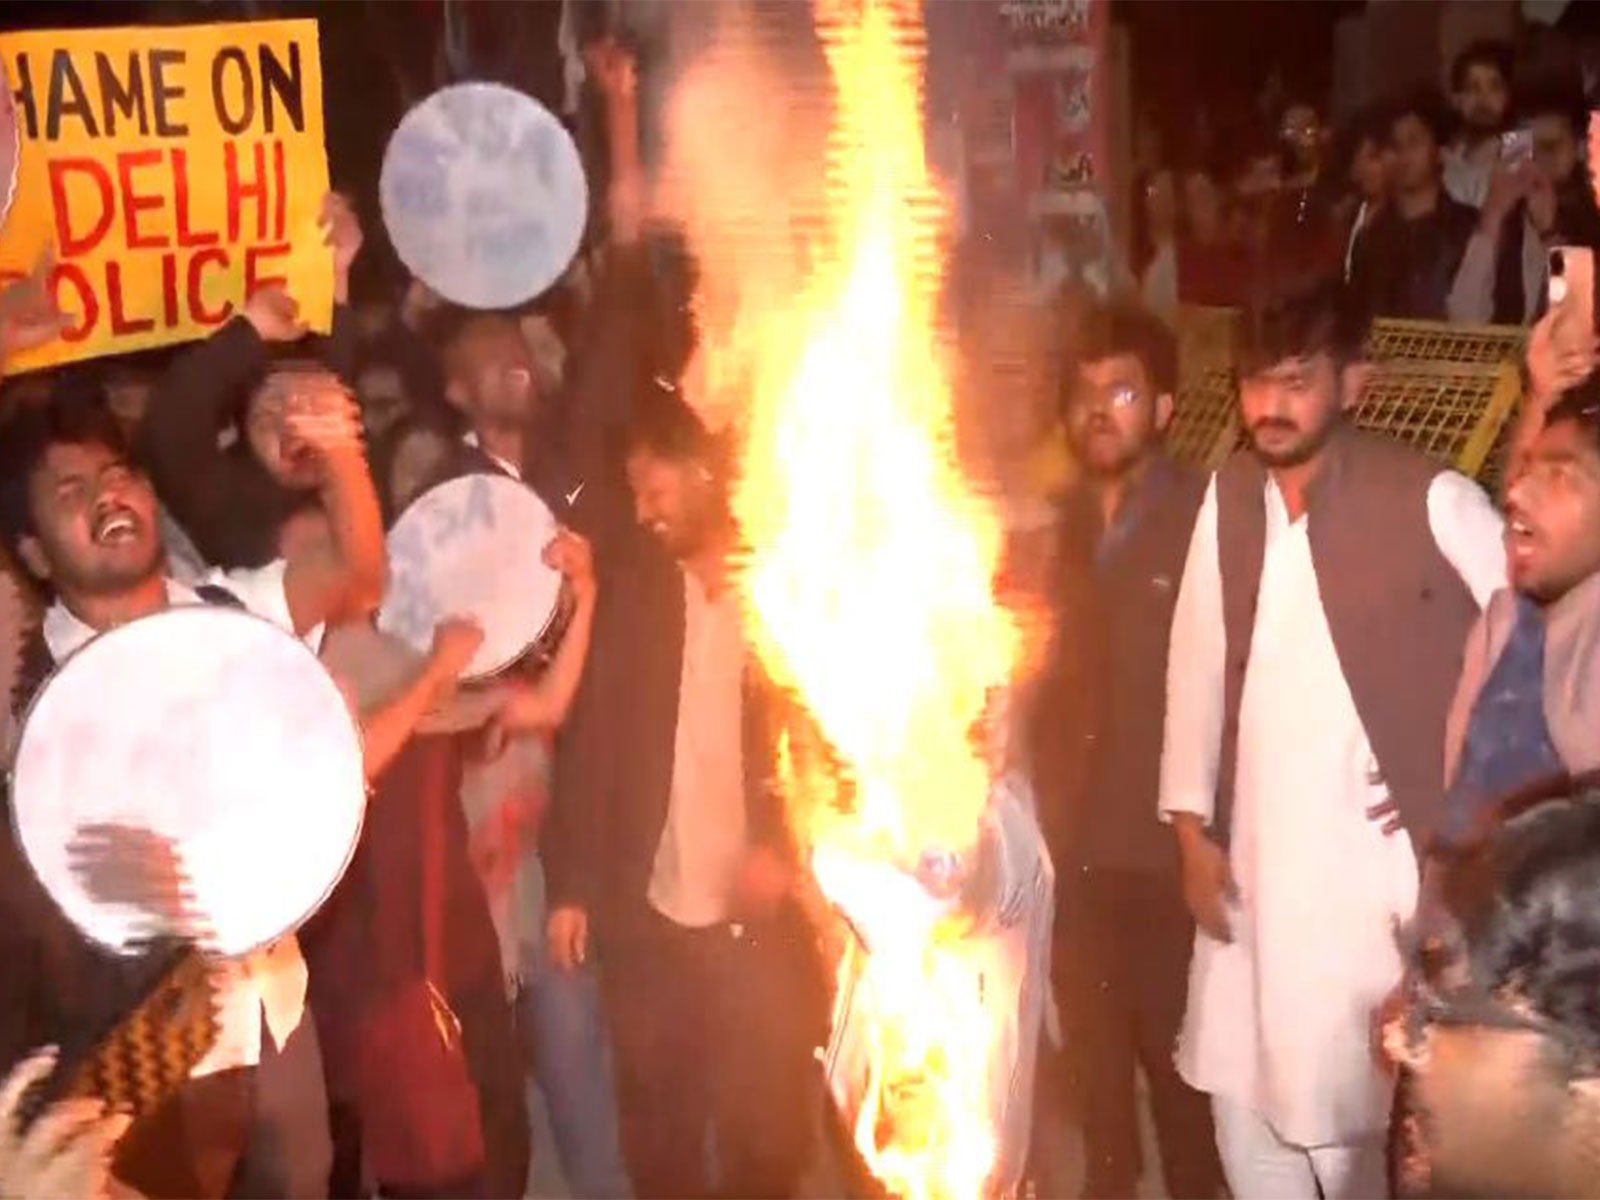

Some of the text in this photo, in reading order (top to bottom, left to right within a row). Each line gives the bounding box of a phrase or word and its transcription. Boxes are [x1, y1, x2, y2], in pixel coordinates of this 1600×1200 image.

[211, 41, 304, 135] ON
[48, 140, 286, 258] DELHI
[0, 242, 291, 342] OLICE
